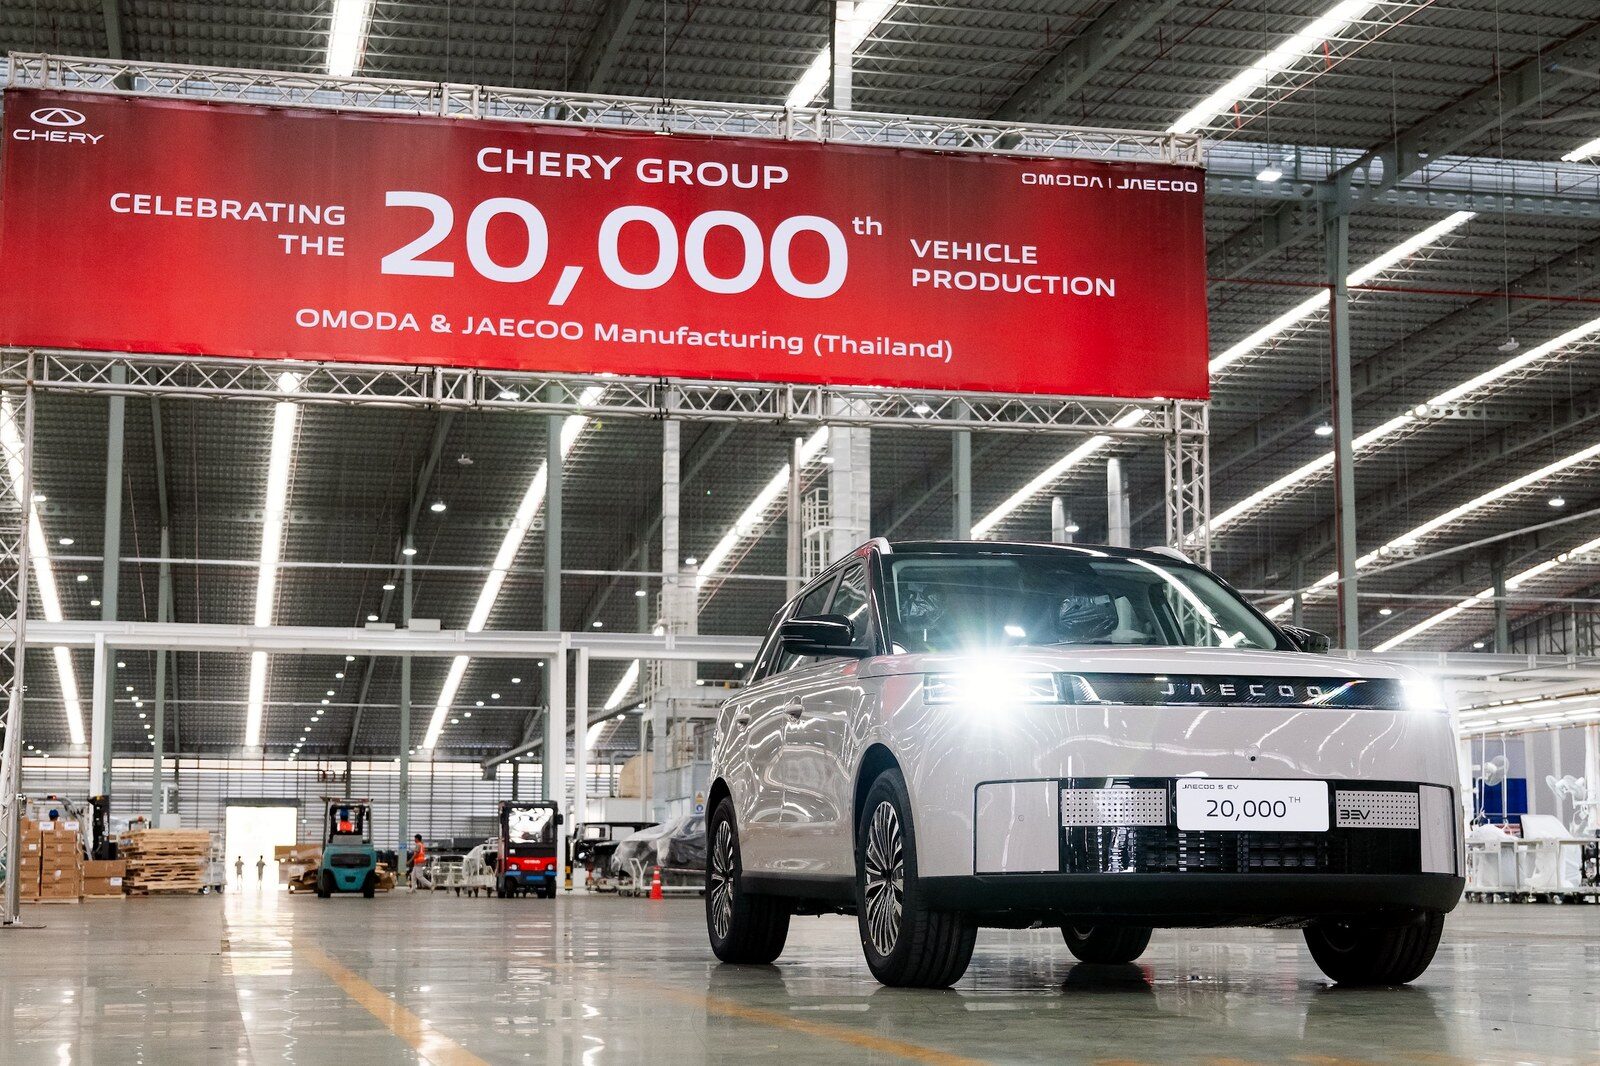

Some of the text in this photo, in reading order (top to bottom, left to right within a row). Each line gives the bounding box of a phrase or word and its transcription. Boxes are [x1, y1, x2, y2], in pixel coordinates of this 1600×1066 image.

[12, 128, 105, 145] CHERY
[476, 146, 789, 190] CHERY GROUP
[1021, 172, 1198, 193] OMODA JAECOO
[110, 192, 346, 226] CELEBRATING
[277, 233, 346, 257] THE
[380, 190, 884, 306] 20,000 th
[909, 238, 1038, 265] VEHICLE
[911, 268, 1116, 298] PRODUCTION
[295, 308, 953, 364] OMODA & JAECOO Manufacturing (Thailand)
[1160, 682, 1324, 698] JAECOO
[1206, 799, 1287, 822] 20,000
